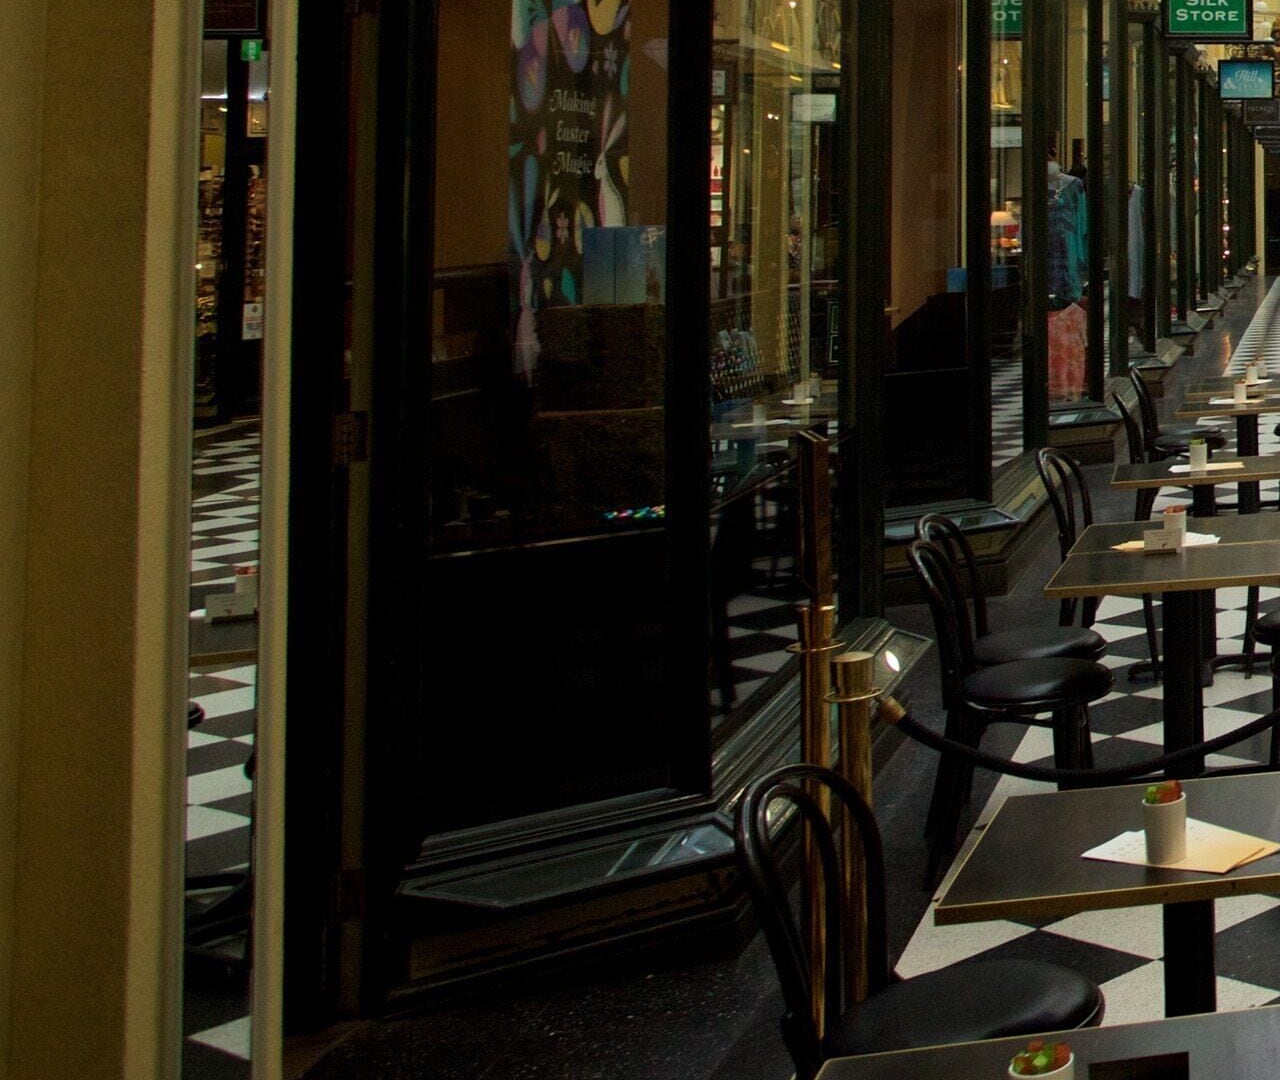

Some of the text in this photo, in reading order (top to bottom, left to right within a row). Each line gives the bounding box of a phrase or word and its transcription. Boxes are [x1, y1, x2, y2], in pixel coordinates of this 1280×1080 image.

[1176, 9, 1239, 21] STORE
[1235, 70, 1259, 81] Hill
[549, 88, 597, 119] Making
[557, 120, 590, 143] Easter
[552, 151, 592, 179] Magic
